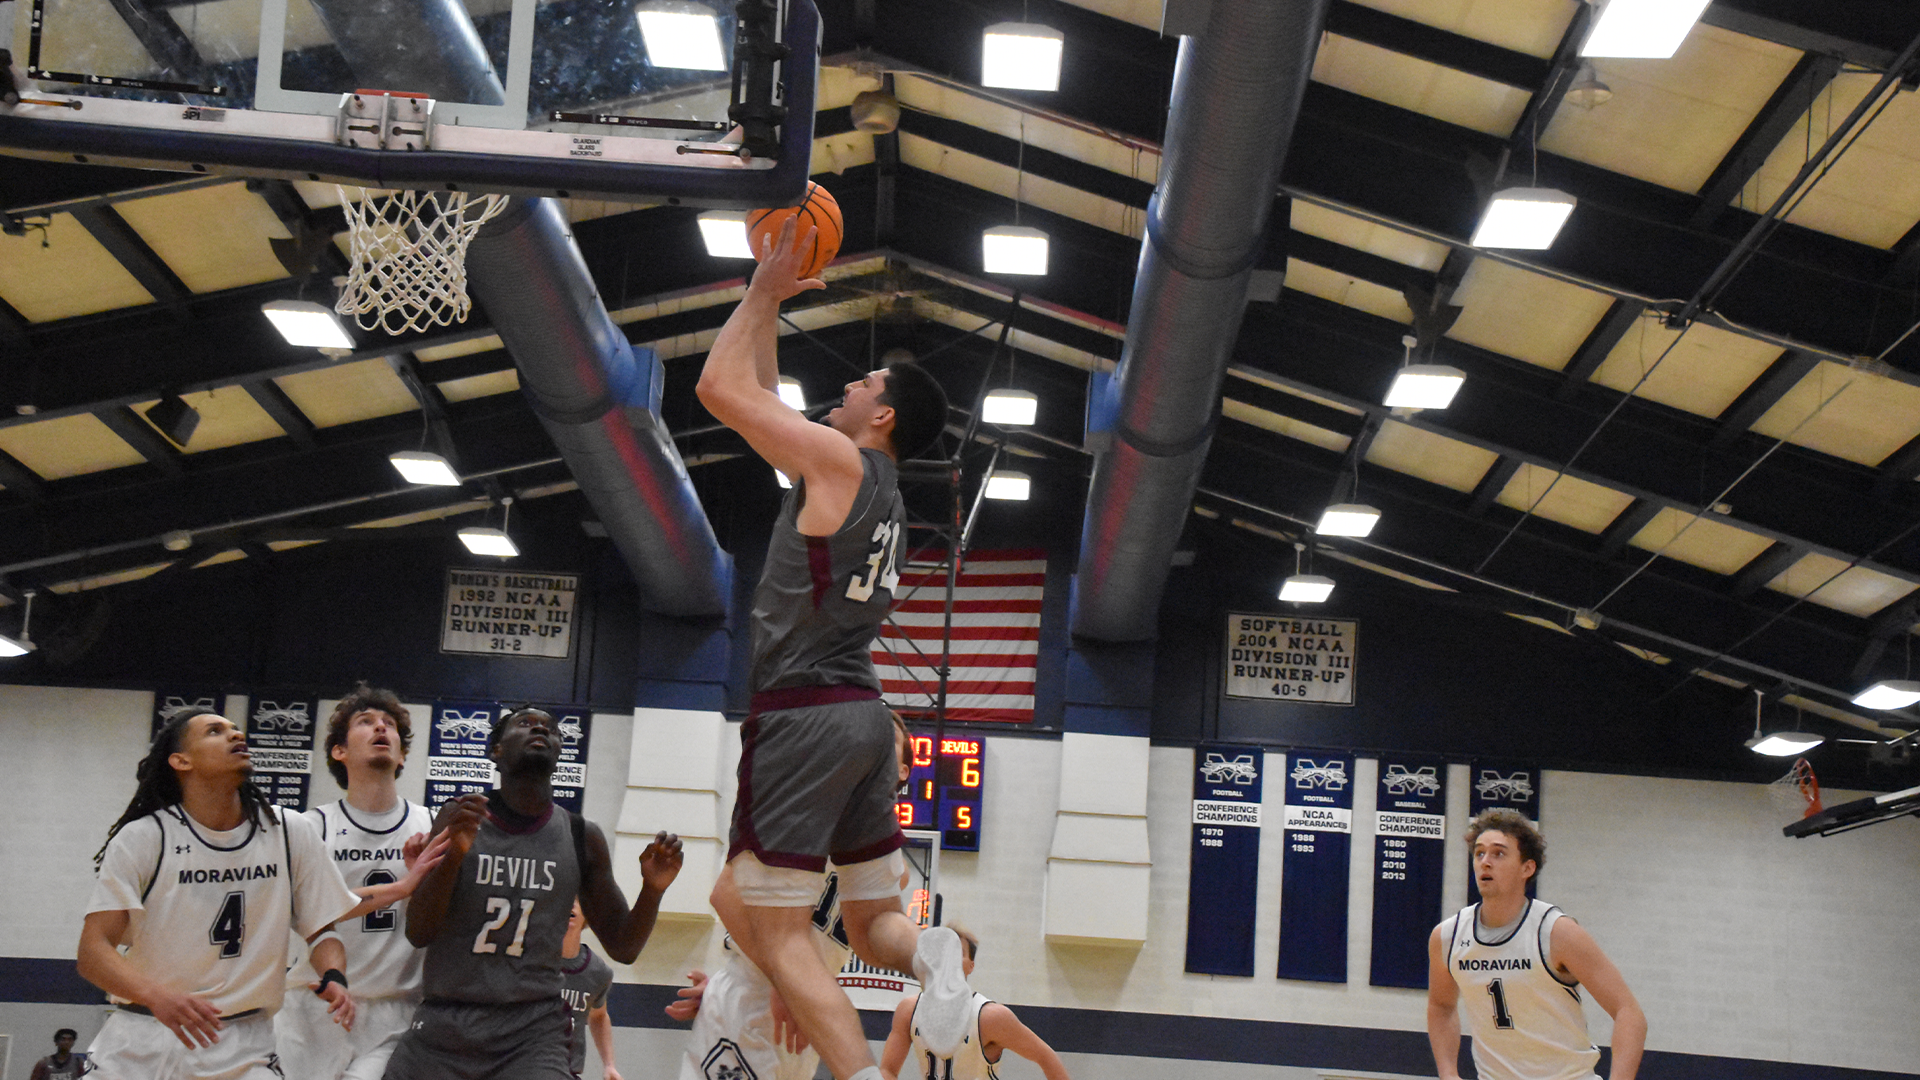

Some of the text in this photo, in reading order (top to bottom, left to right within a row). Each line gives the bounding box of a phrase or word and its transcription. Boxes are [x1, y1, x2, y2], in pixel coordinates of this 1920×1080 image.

[450, 573, 575, 591] WOMEN'S BASKETBALL
[460, 589, 561, 607] 1992 NCAA
[450, 604, 568, 623] DIVISION III
[450, 619, 562, 638] RUNNER-UP
[1241, 619, 1342, 637] SOFTBALL
[490, 637, 522, 651] 31-2
[1238, 634, 1344, 652] 2004 NCAA
[1231, 649, 1350, 668] DIVISION III
[1234, 664, 1345, 683] RUNNER-UP
[1271, 683, 1307, 697] 40-6
[940, 740, 979, 755] DEVILS
[430, 760, 492, 770] CONFERENCE
[429, 769, 491, 779] CHAMPIONS
[551, 774, 582, 784] PIONS
[961, 757, 980, 788] 6
[461, 785, 484, 793] 2019
[925, 780, 933, 800] 1
[1212, 789, 1243, 797] FOOTBALL
[1303, 795, 1334, 803] FOOTBALL
[1395, 801, 1426, 809] BASEBALL
[895, 802, 972, 829] 3 5
[1197, 803, 1258, 814] CONFERENCE
[1302, 810, 1334, 820] NCAA
[1197, 812, 1257, 823] CHAMPIONS
[1288, 819, 1348, 830] APPEARANCES
[1379, 815, 1441, 826] CONFERENCE
[1200, 828, 1223, 837] 1970
[1379, 824, 1441, 835] CHAMPIONS
[334, 848, 404, 862] MORAVI
[1382, 860, 1406, 869] 2010
[178, 863, 278, 884] MORAVIAN
[476, 853, 556, 891] DEVILS
[1382, 871, 1406, 880] 2013
[208, 890, 245, 959] 4
[472, 897, 535, 958] 21
[1458, 958, 1532, 971] MORAVIAN
[838, 978, 901, 990] ONFERENCE
[561, 988, 591, 1012] VILS
[1486, 978, 1514, 1029] 1
